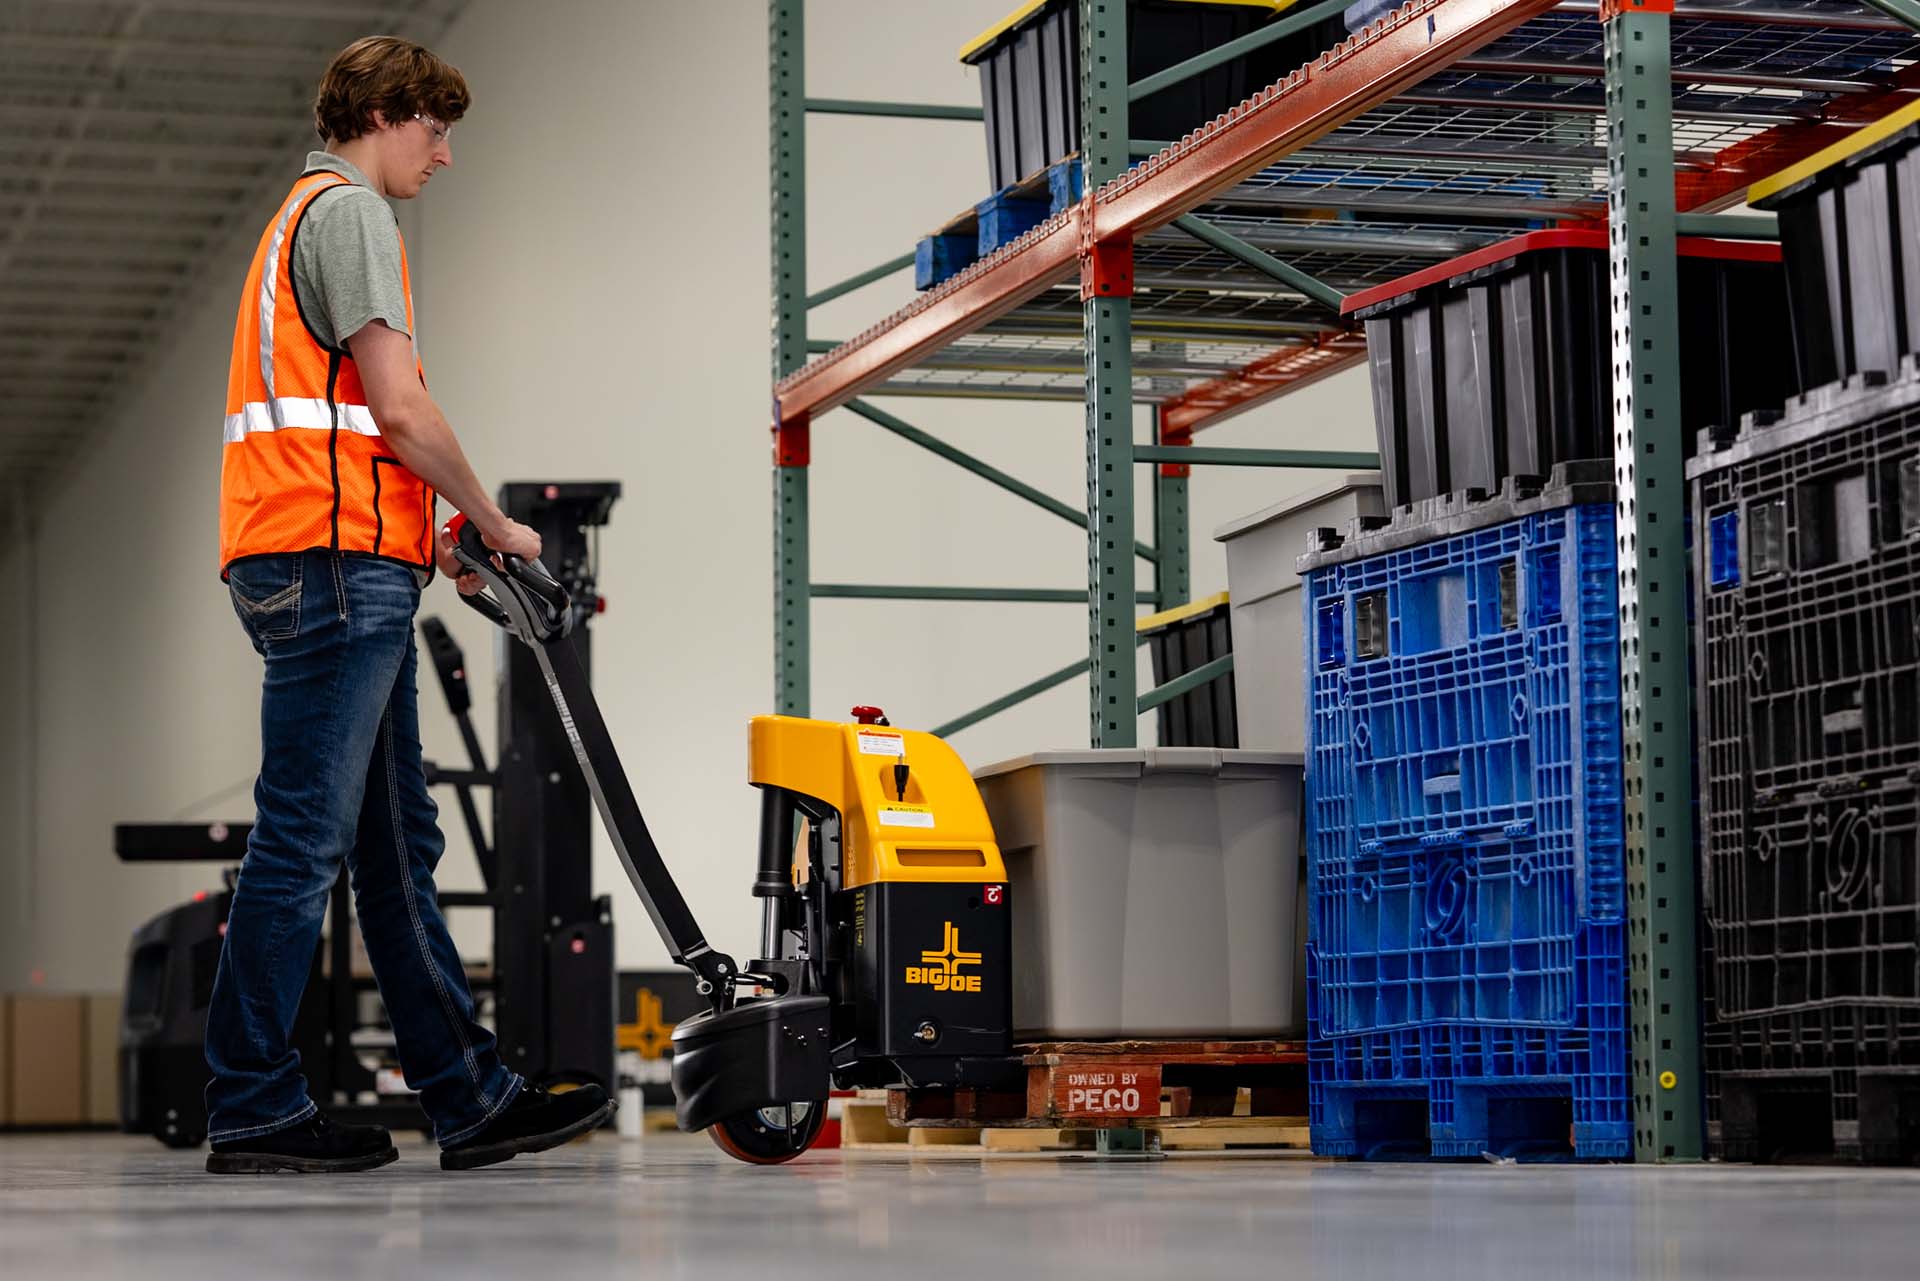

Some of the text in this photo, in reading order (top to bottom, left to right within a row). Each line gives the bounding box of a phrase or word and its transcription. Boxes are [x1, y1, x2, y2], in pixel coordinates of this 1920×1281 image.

[1068, 1072, 1138, 1086] OWNED BY
[1068, 1088, 1140, 1112] PECO
